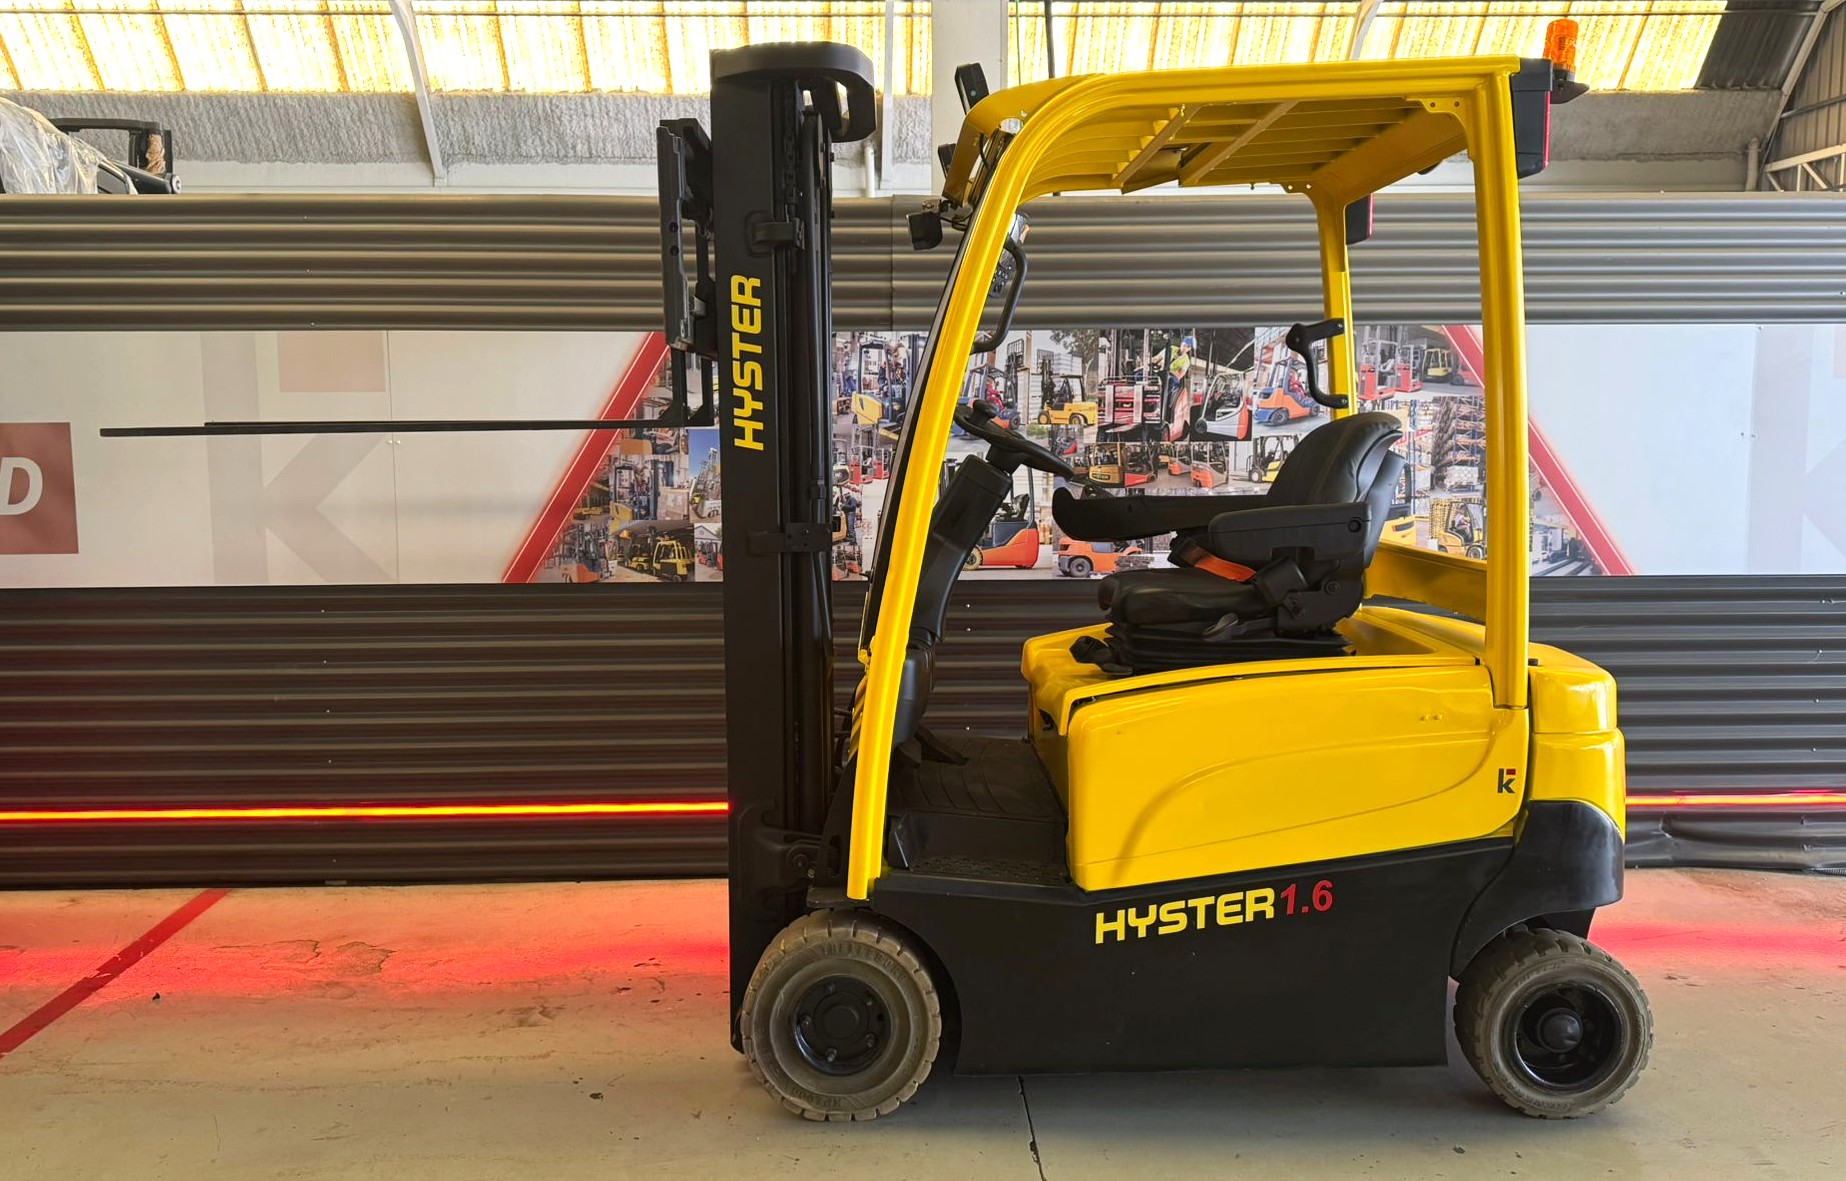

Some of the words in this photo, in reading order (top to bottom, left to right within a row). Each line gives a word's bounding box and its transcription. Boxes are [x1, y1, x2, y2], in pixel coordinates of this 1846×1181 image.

[731, 274, 764, 451] HYSTER
[1095, 887, 1275, 945] HYSTER
[1281, 879, 1334, 916] 1.6
